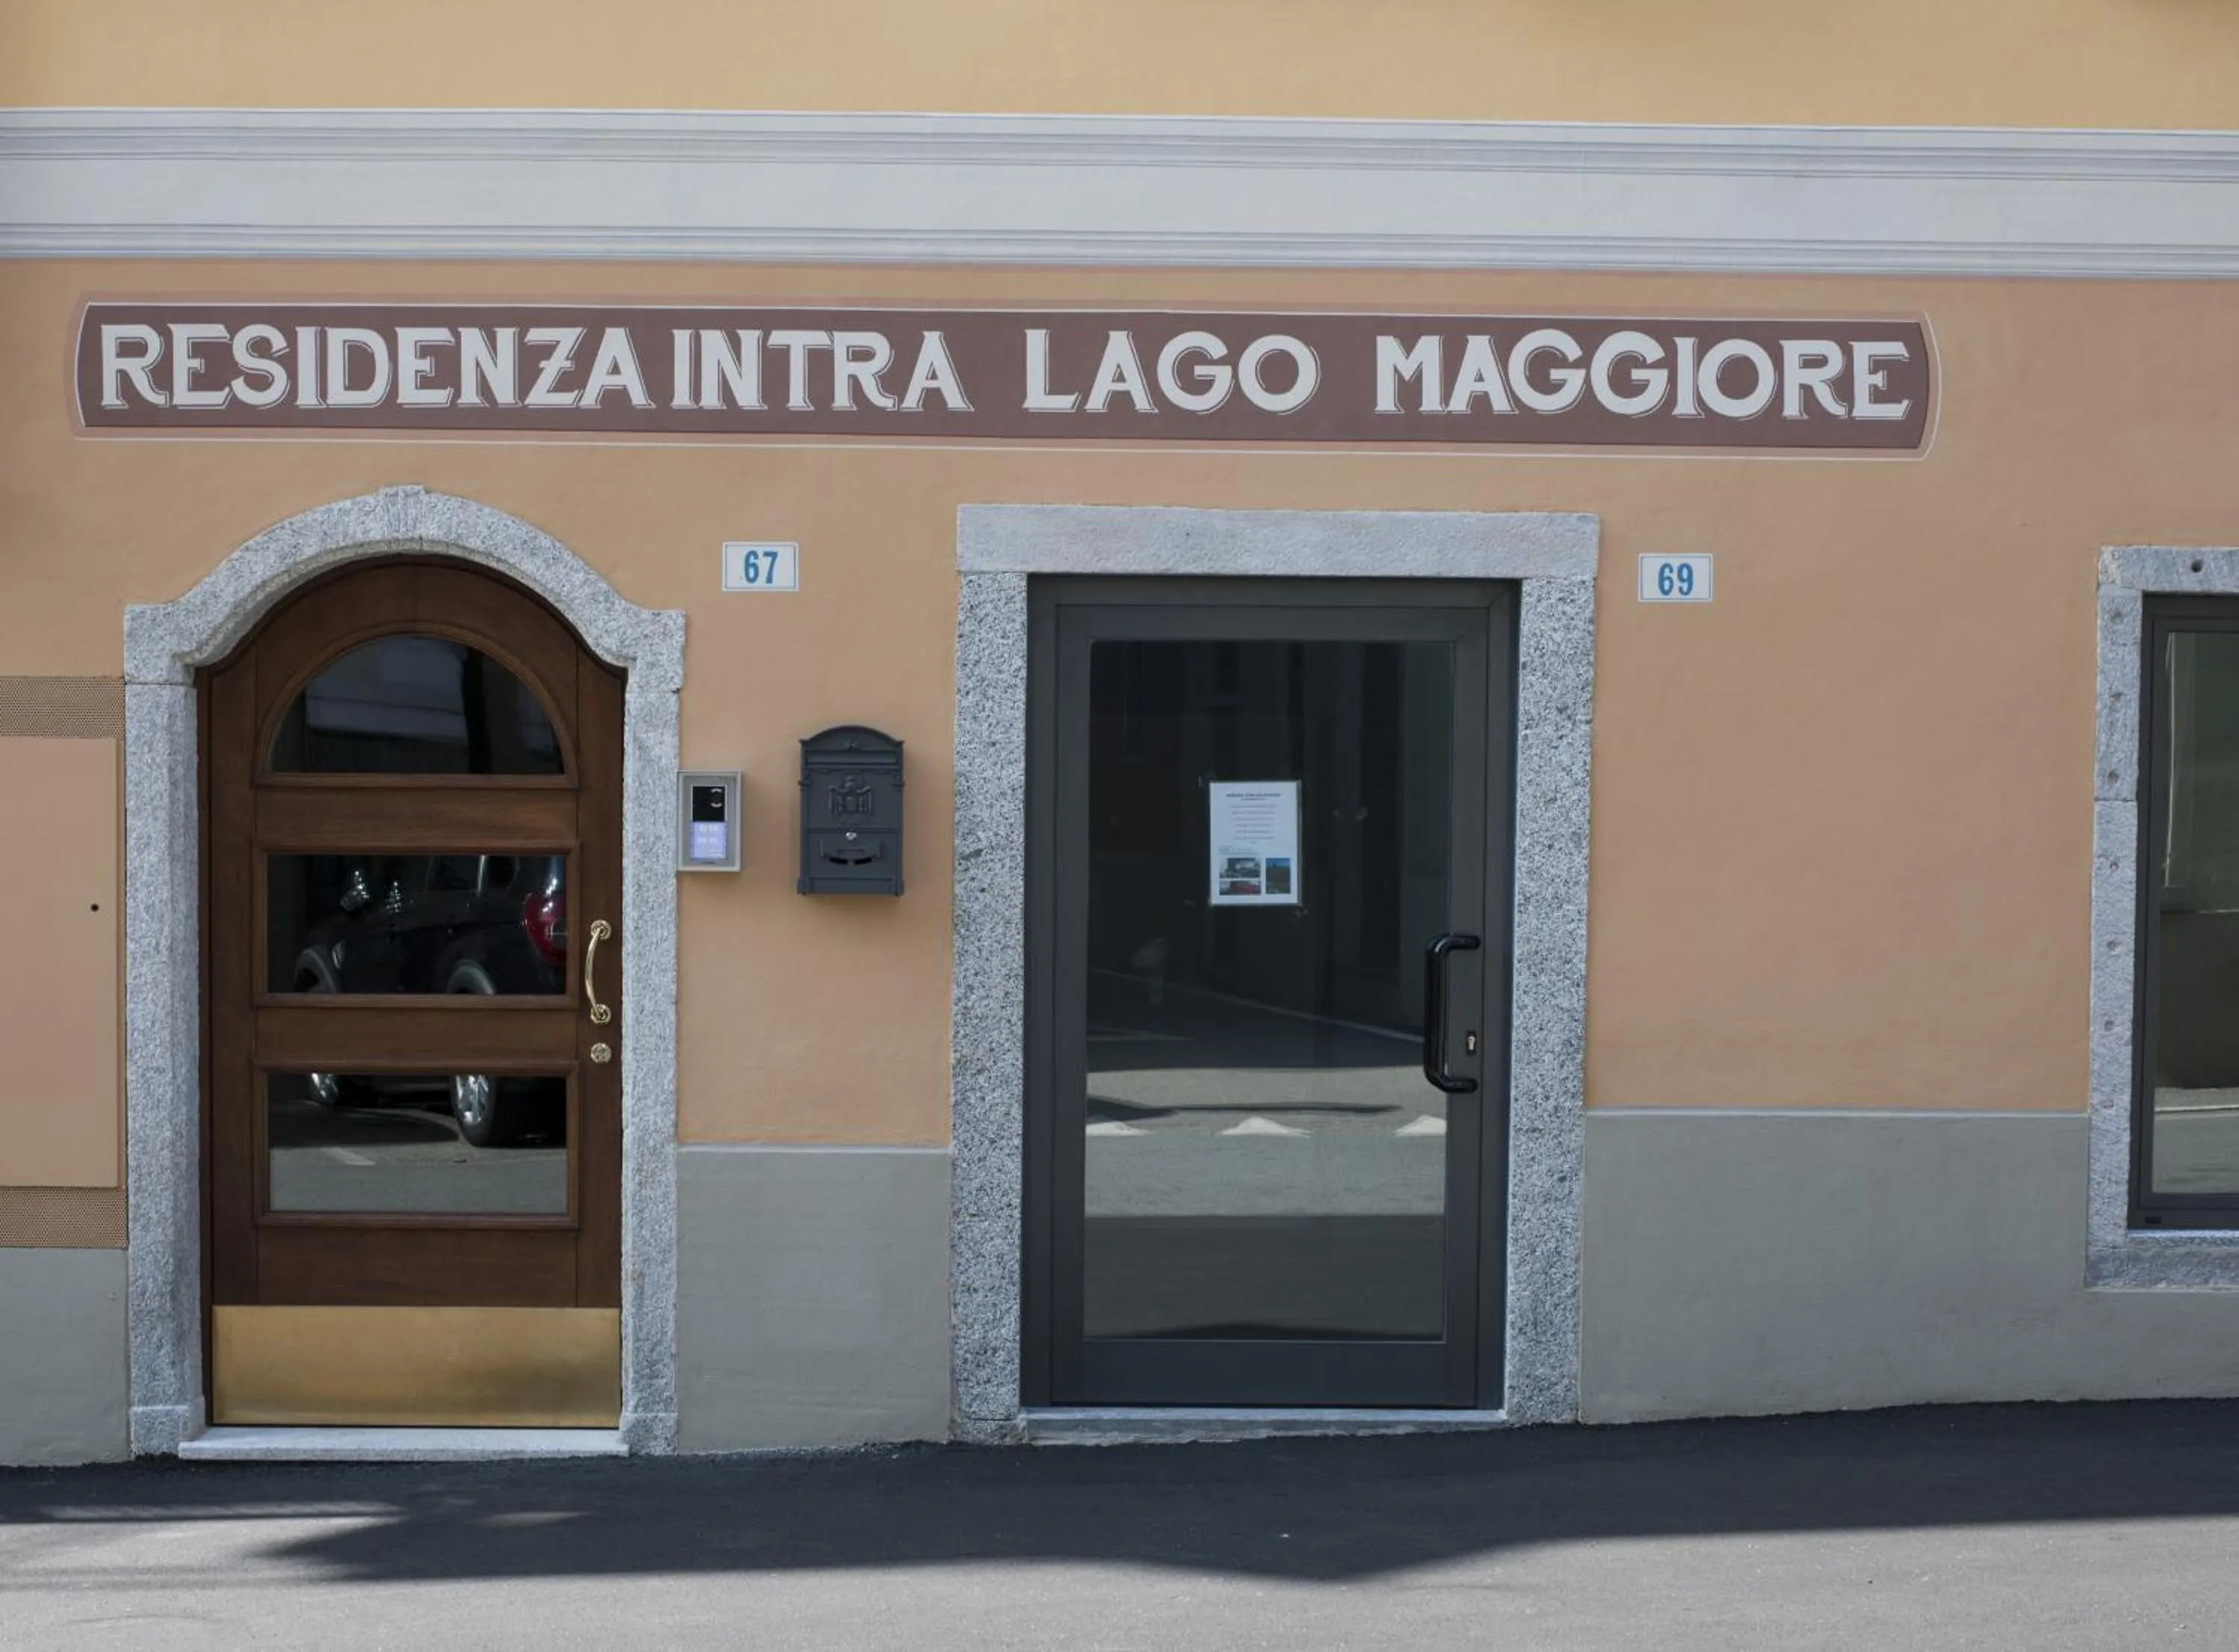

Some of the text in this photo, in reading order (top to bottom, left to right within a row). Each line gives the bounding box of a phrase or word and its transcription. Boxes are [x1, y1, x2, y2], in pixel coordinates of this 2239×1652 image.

[101, 323, 1912, 421] RESIDENZA INTRA LAGO MAGGIORE
[744, 550, 778, 584] 67
[1658, 562, 1693, 596] 69
